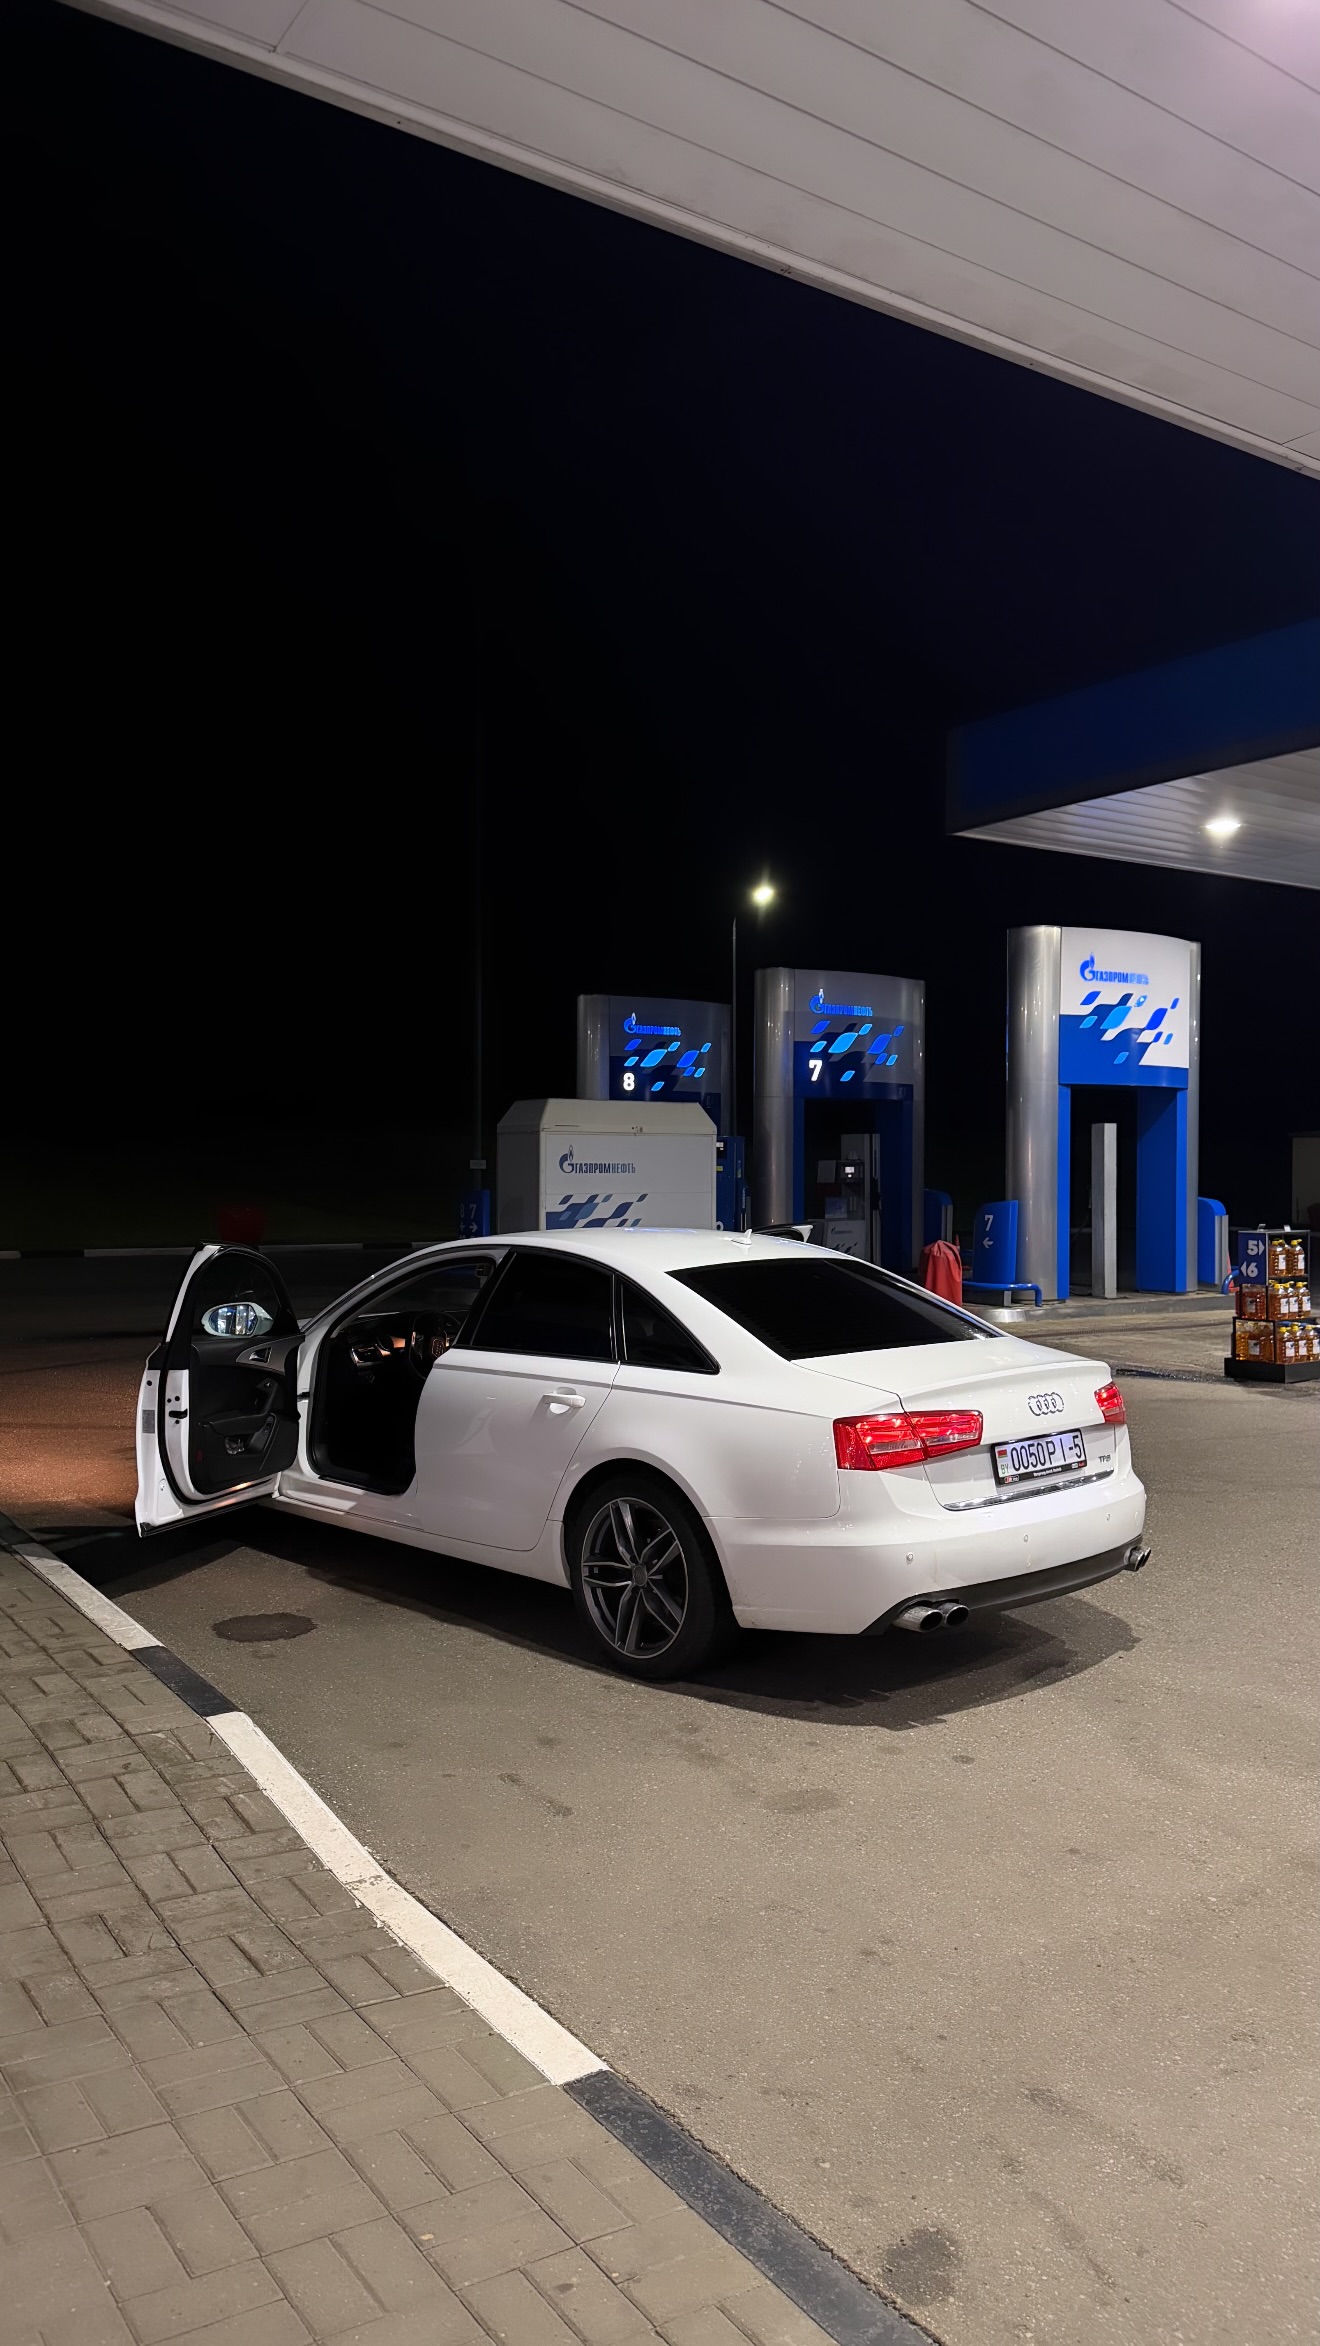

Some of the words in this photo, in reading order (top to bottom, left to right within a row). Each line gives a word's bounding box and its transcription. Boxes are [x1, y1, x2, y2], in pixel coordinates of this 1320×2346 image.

[1095, 970, 1149, 986] ГАЗПРОМ
[808, 1059, 823, 1082] 7
[623, 1072, 635, 1091] 8
[575, 1163, 636, 1174] ГАЗПРОМНЕФТЬ
[469, 1203, 477, 1220] 7
[984, 1214, 994, 1232] 7
[1247, 1240, 1259, 1256] 5
[1247, 1262, 1259, 1278] 6
[1001, 1463, 1010, 1475] BY
